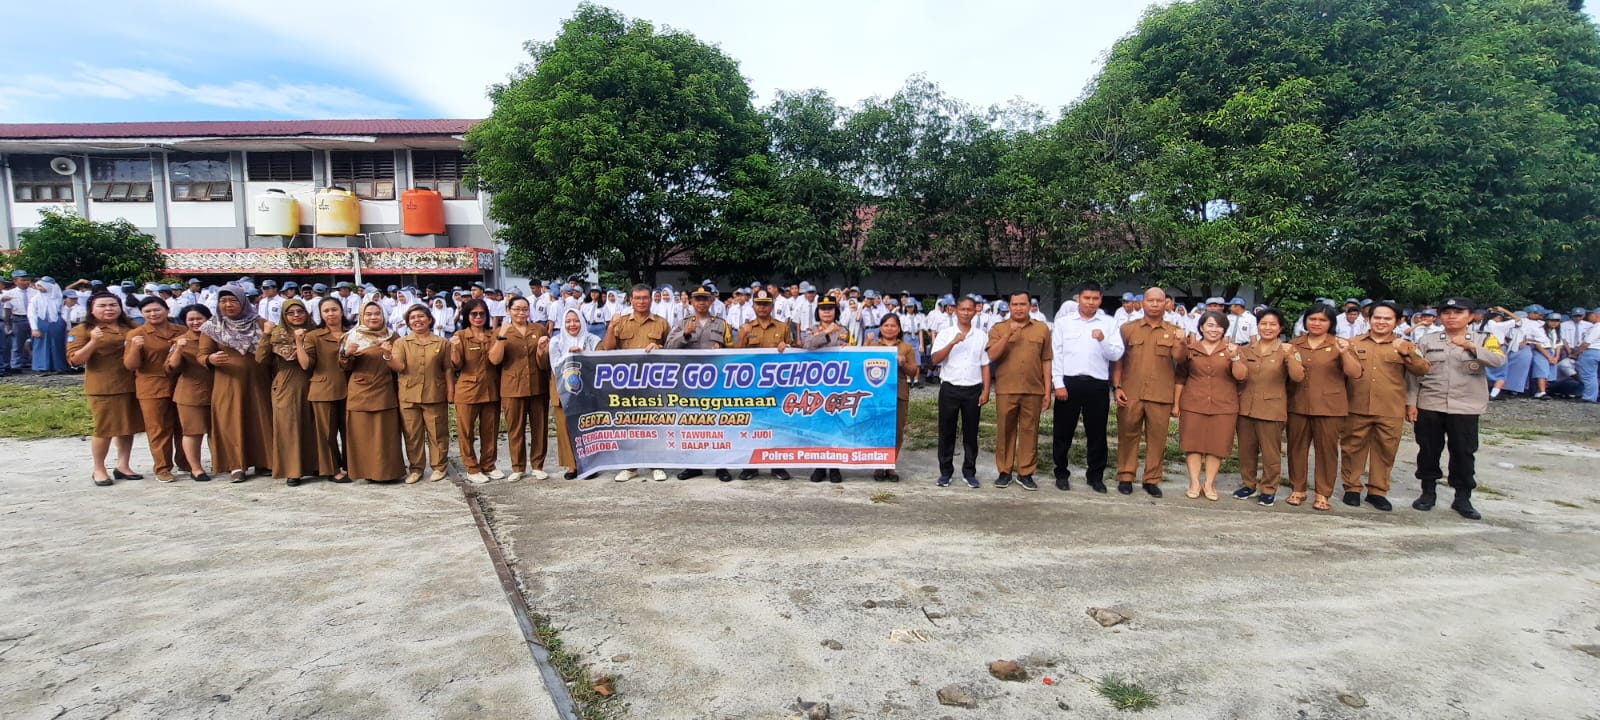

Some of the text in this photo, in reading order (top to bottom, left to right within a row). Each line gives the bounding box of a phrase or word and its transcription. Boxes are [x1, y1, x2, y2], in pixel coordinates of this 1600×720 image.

[595, 362, 851, 388] POLICE GO TO SCHOOL
[608, 394, 776, 410] Batasi Penggunaan
[579, 413, 751, 430] SERTA JAUHKAN ANAK DARI
[582, 430, 657, 443] PERGAULAN BEBAS
[681, 431, 724, 439] TAWURAN
[752, 431, 771, 439] JUDI
[681, 441, 731, 450] BALAP LIAR
[762, 450, 888, 462] Polres Pematang Siantar
